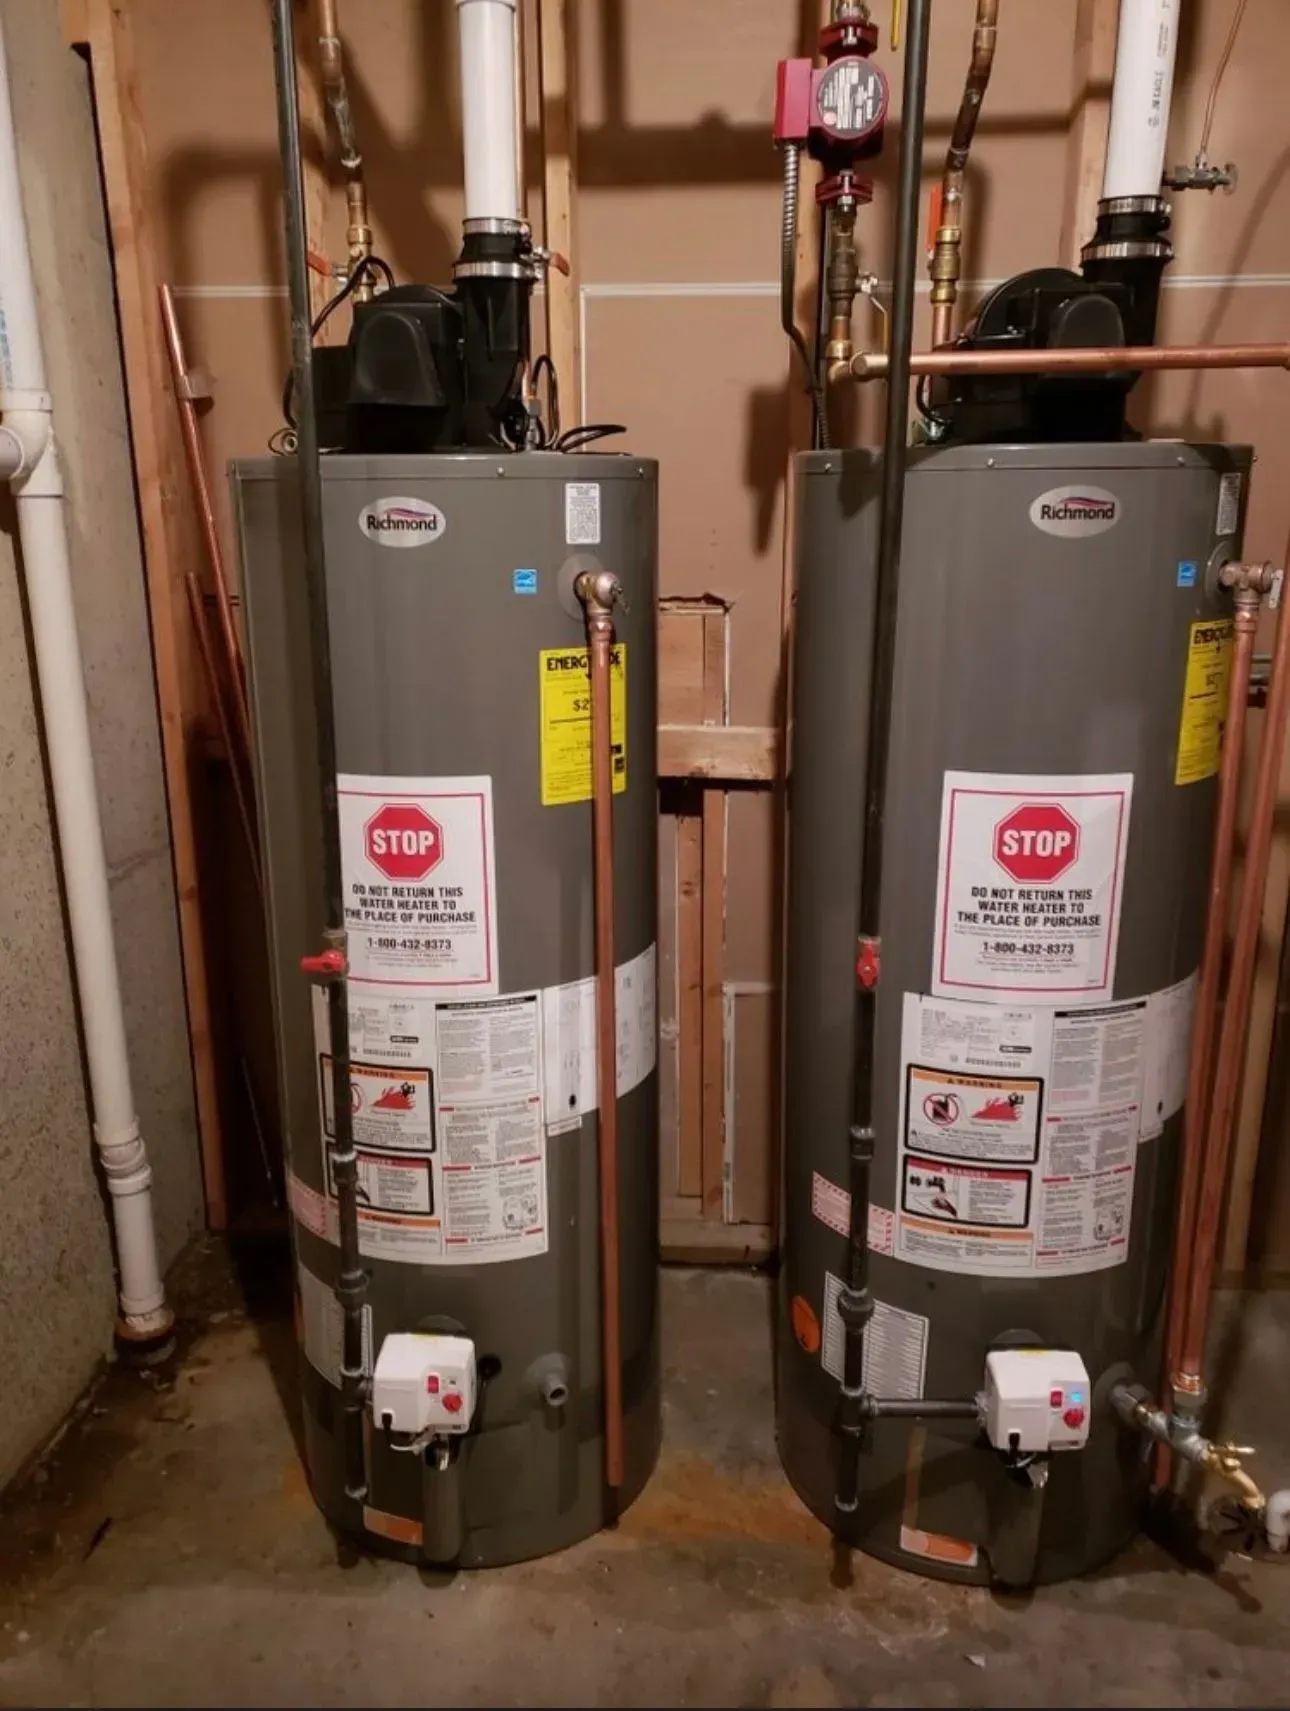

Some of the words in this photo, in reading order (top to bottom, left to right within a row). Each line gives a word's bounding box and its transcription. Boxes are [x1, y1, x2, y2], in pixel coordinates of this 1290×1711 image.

[1040, 503, 1115, 521] Richmond
[367, 514, 437, 531] Richmond
[373, 828, 434, 856] STOP
[1002, 830, 1071, 857] STOP
[352, 884, 366, 896] DO
[368, 885, 388, 897] NOT
[392, 886, 434, 898] RETURN
[438, 887, 463, 898] THIS
[971, 887, 987, 898] DO
[991, 888, 1014, 899] NOT
[1018, 889, 1064, 901] RETURN
[1068, 889, 1092, 900] THIS
[360, 898, 394, 909] WATER
[398, 900, 438, 911] HEATER
[443, 900, 457, 910] TO
[978, 901, 1018, 913] WATER
[1023, 902, 1066, 914] HEATER
[1071, 903, 1084, 913] TO
[365, 909, 397, 922] PLACE
[400, 911, 413, 923] OF
[418, 911, 476, 923] PURCHASE
[957, 911, 978, 924] THE
[982, 914, 1020, 926] PLACE
[1024, 915, 1040, 927] OF
[1044, 915, 1101, 927] PURCHASE
[368, 937, 452, 950] 1-800-432-8373
[983, 942, 1074, 955] 1-800-432-8373
